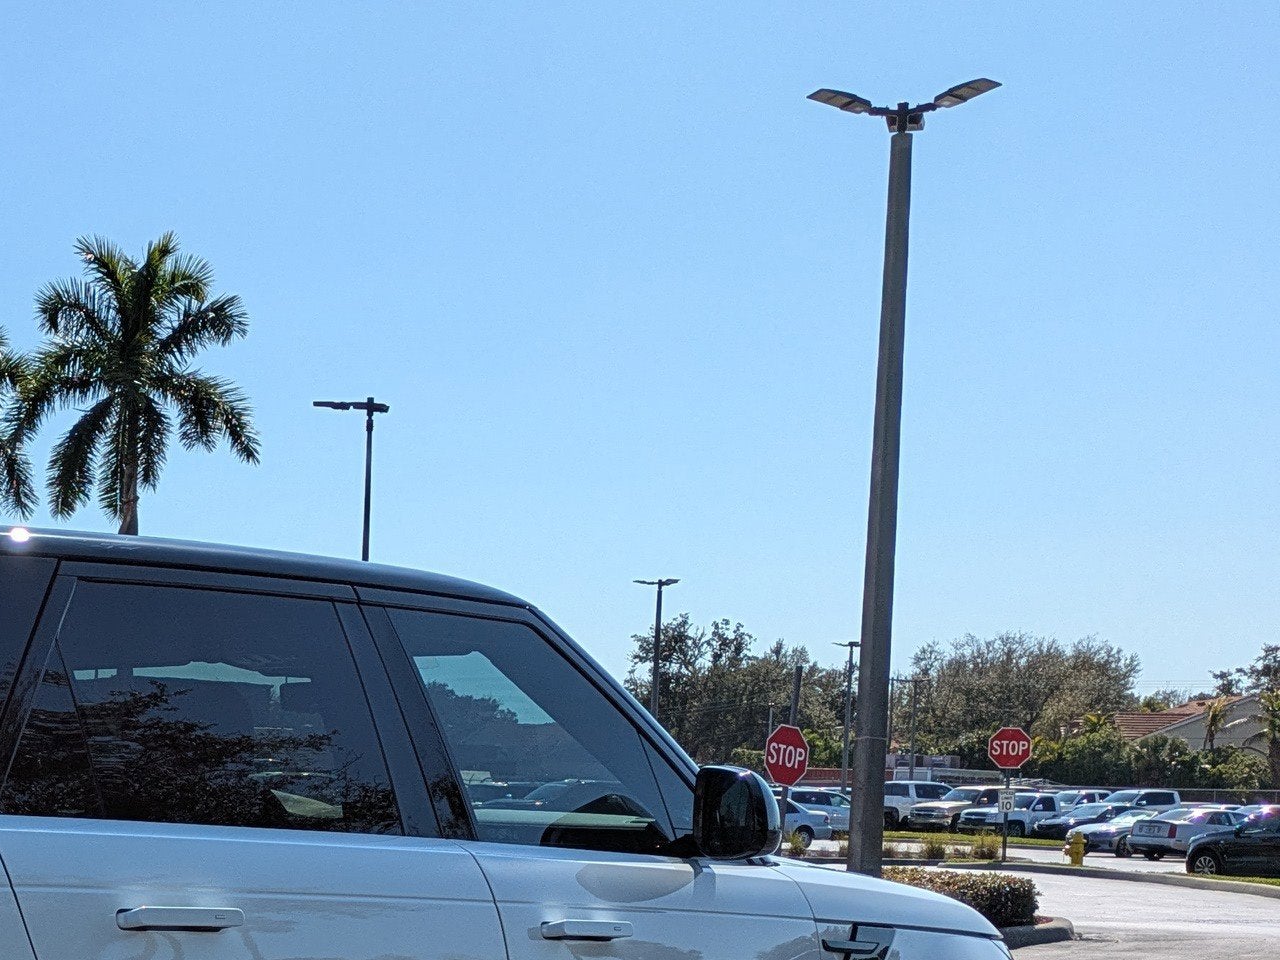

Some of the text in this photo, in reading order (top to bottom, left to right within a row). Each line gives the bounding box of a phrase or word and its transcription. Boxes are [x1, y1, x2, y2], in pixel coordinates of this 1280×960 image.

[768, 742, 806, 769] STOP
[991, 740, 1029, 756] STOP
[1001, 801, 1012, 811] 10
